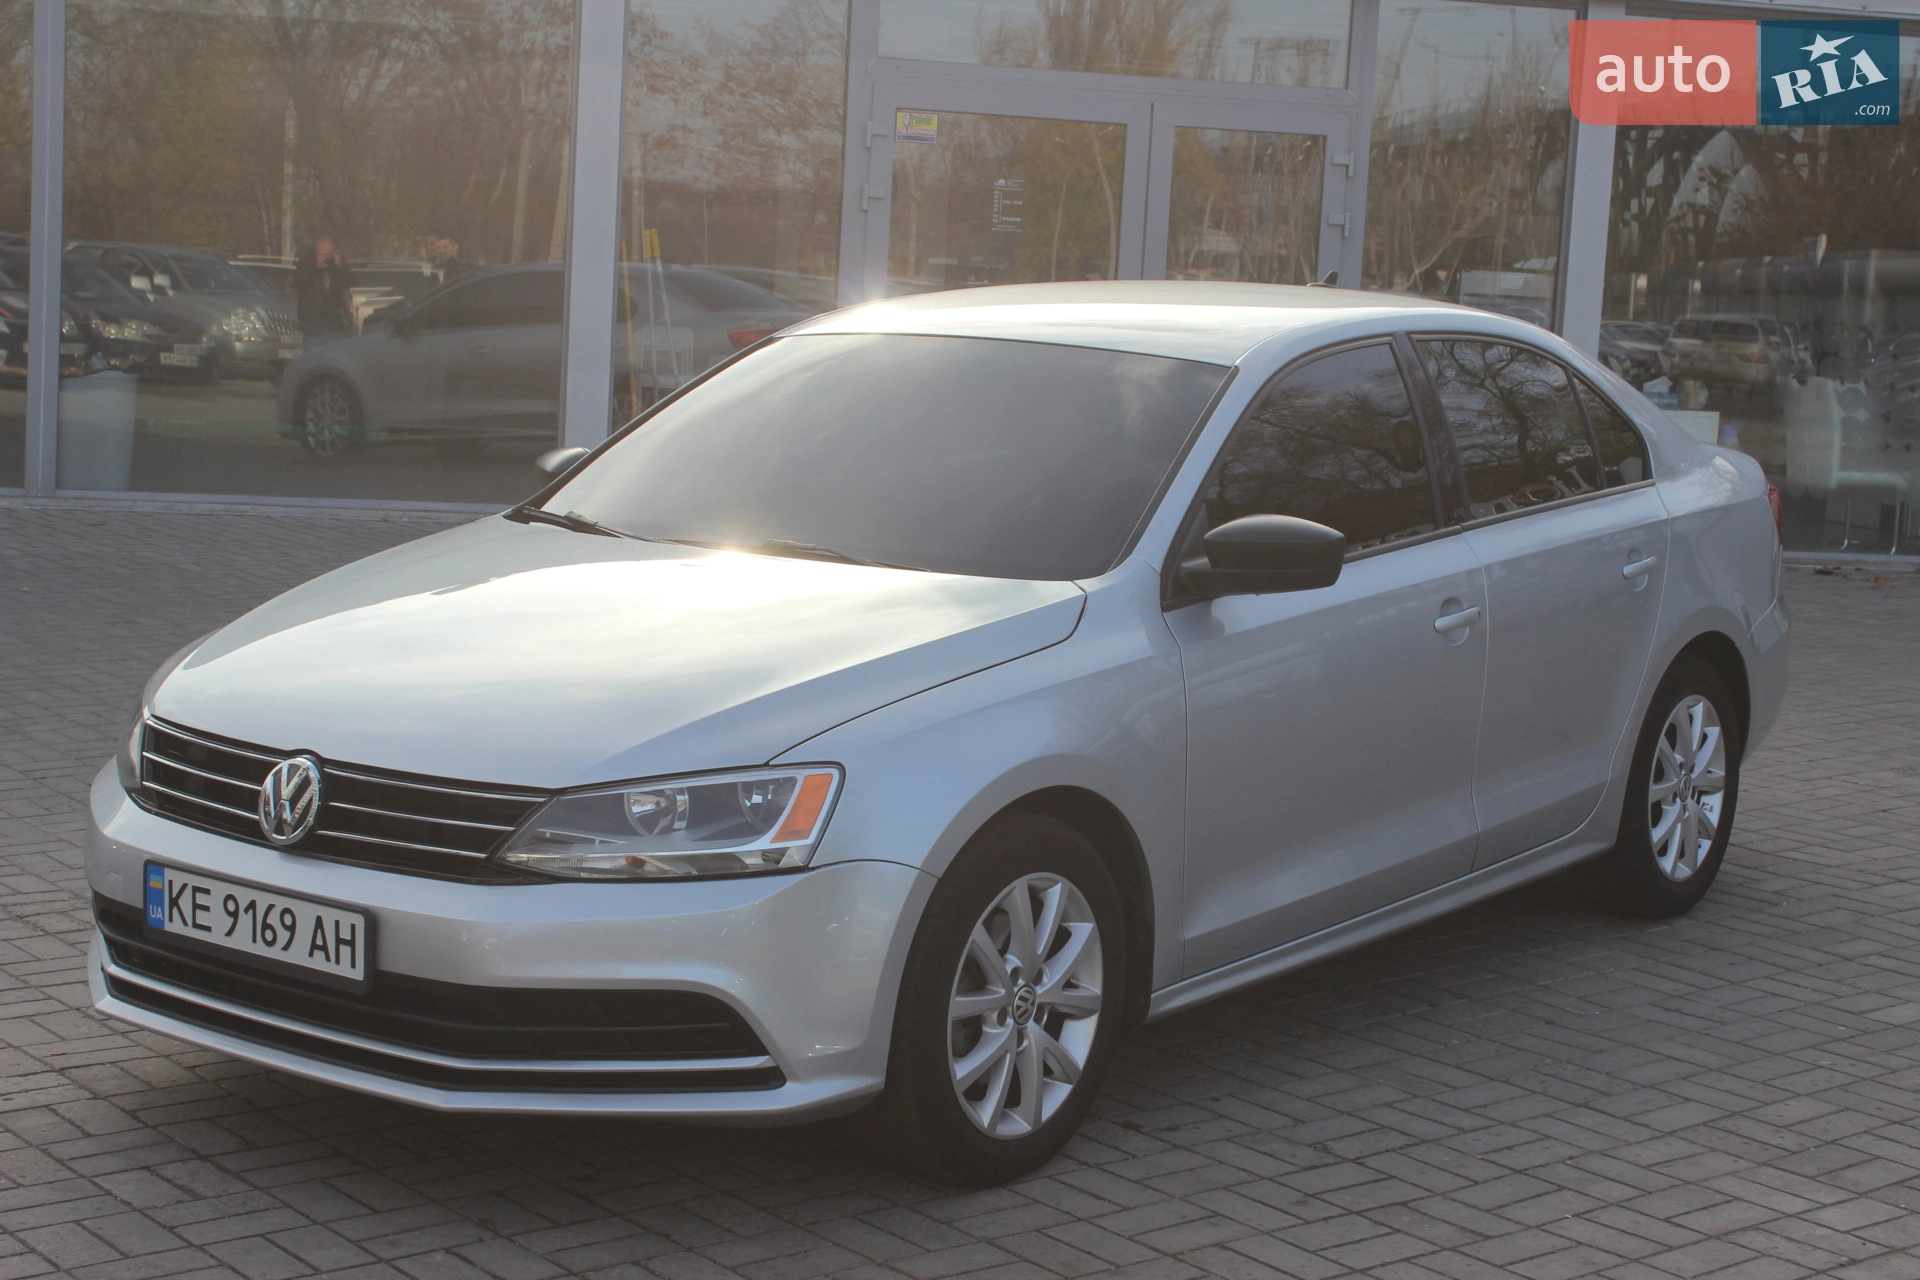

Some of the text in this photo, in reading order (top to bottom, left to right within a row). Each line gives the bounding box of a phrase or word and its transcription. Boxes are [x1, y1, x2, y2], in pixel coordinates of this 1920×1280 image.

[149, 905, 163, 920] UA
[168, 879, 356, 969] KE 9169 AH
